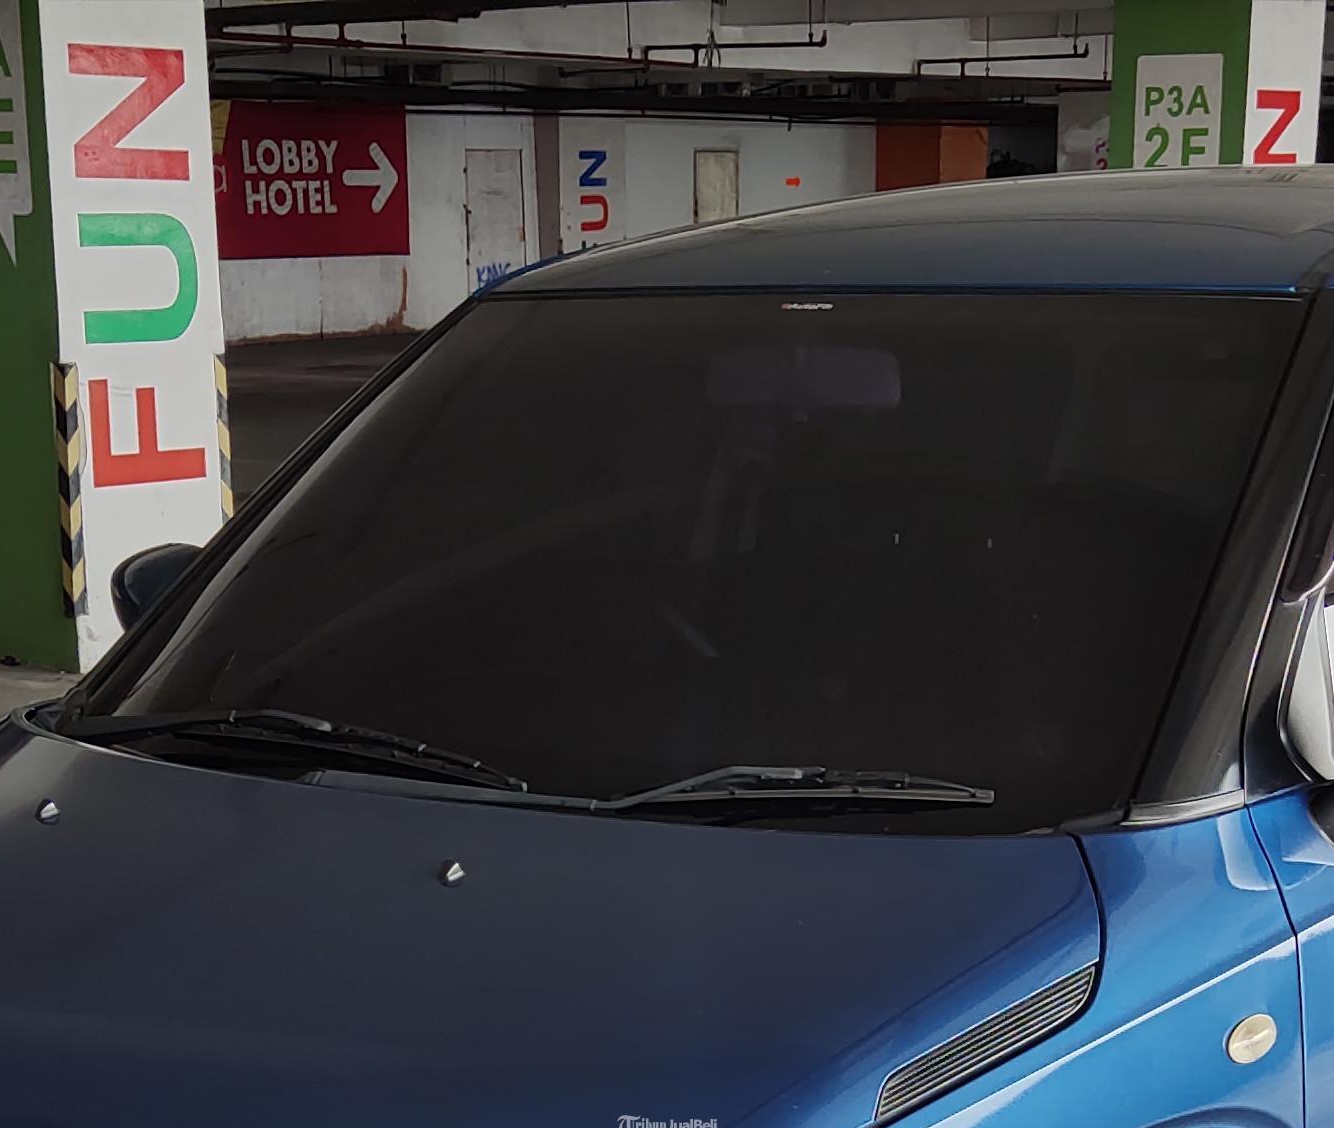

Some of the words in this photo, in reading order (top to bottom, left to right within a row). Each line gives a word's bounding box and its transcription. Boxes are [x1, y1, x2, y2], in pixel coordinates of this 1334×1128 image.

[1145, 85, 1211, 117] P3A
[241, 139, 338, 174] LOBBY
[245, 180, 338, 215] HOTEL
[579, 151, 609, 250] UN
[67, 43, 207, 488] FUN
